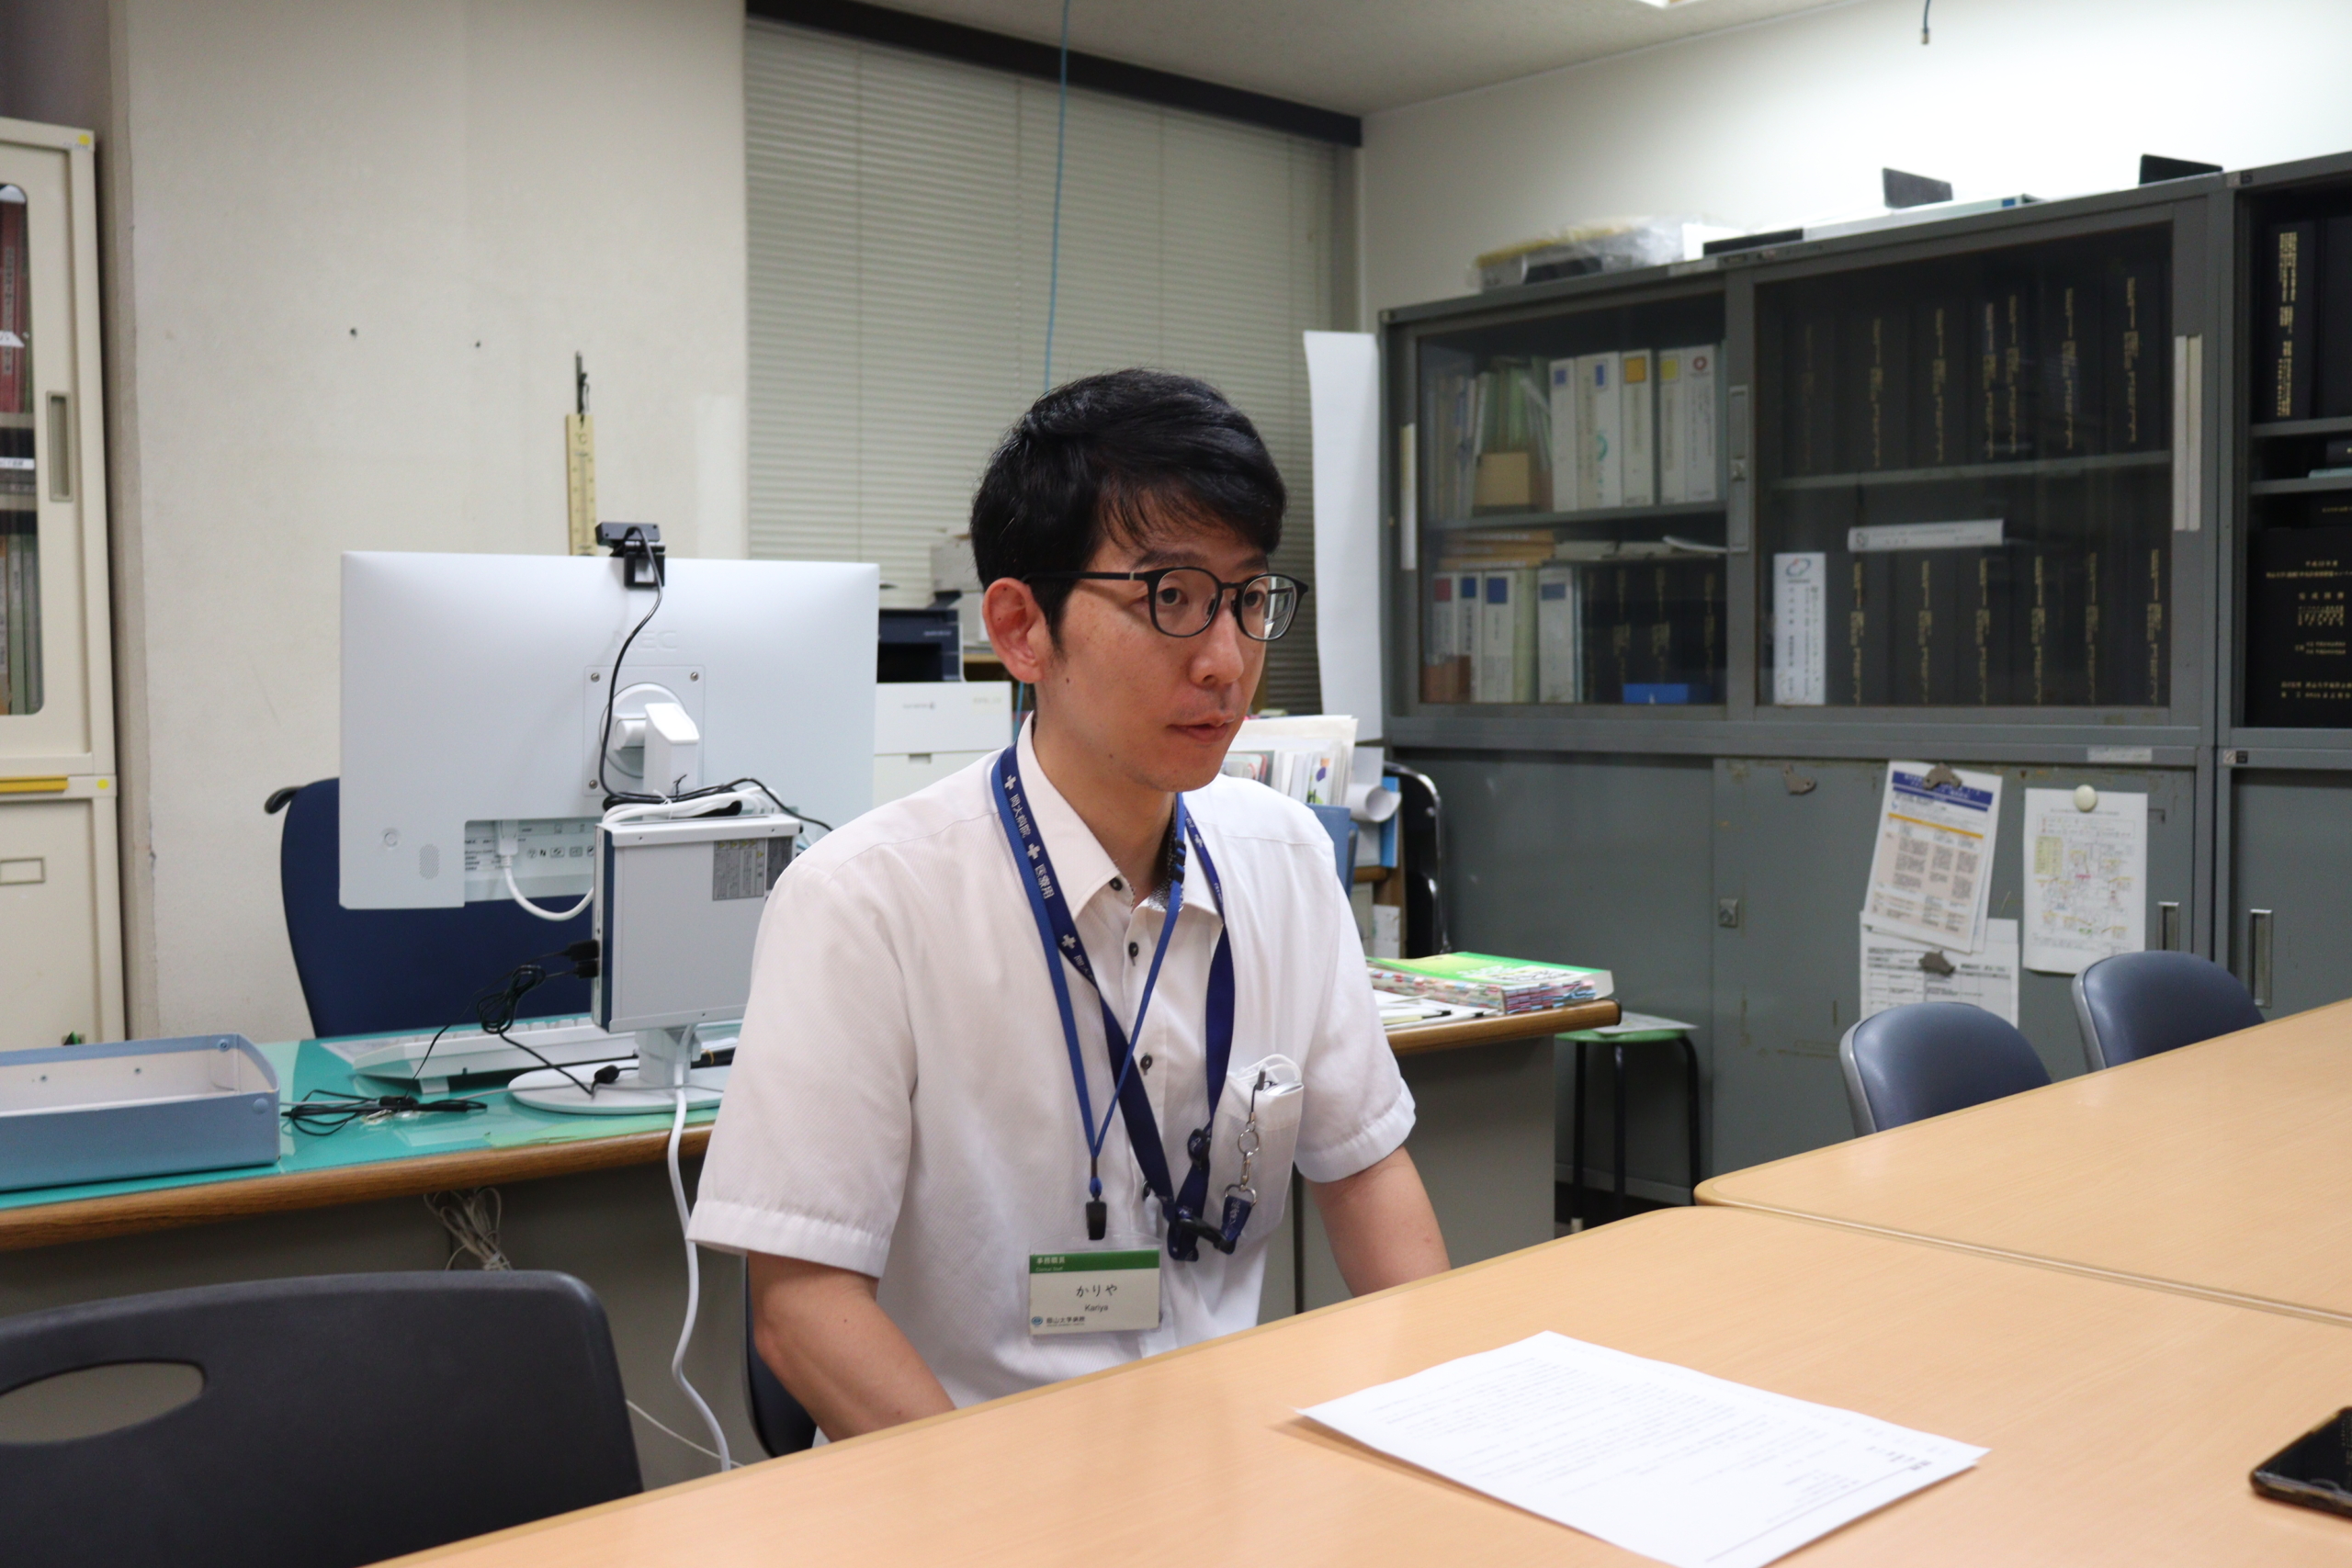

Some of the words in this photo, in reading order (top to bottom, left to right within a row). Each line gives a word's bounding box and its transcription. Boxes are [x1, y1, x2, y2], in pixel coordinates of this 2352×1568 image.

[1034, 863, 1056, 900] 医療用
[1076, 1283, 1118, 1298] かりや
[1084, 1303, 1109, 1314] Kariya
